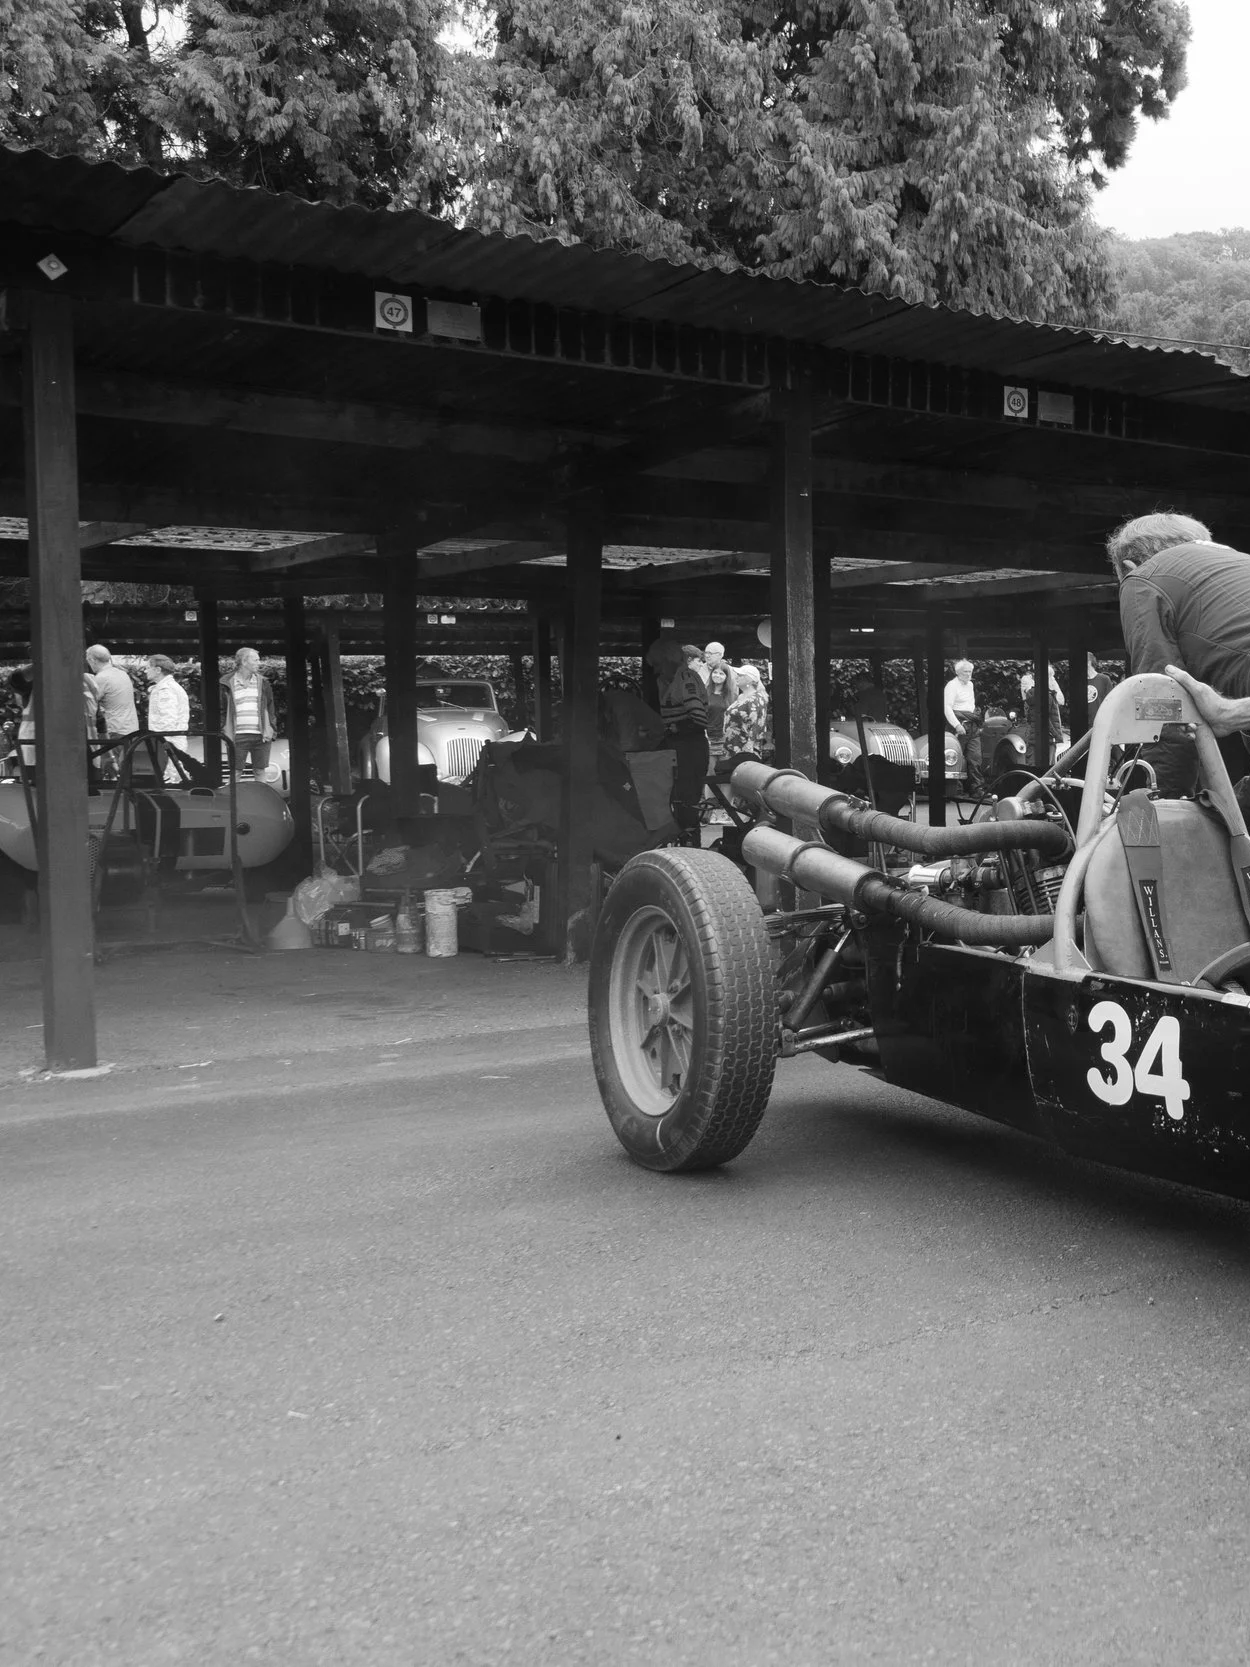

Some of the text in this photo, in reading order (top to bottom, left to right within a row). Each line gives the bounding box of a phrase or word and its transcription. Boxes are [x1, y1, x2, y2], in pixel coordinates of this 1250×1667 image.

[386, 307, 402, 318] 47
[1011, 398, 1022, 407] 48
[1087, 1001, 1190, 1120] 34
